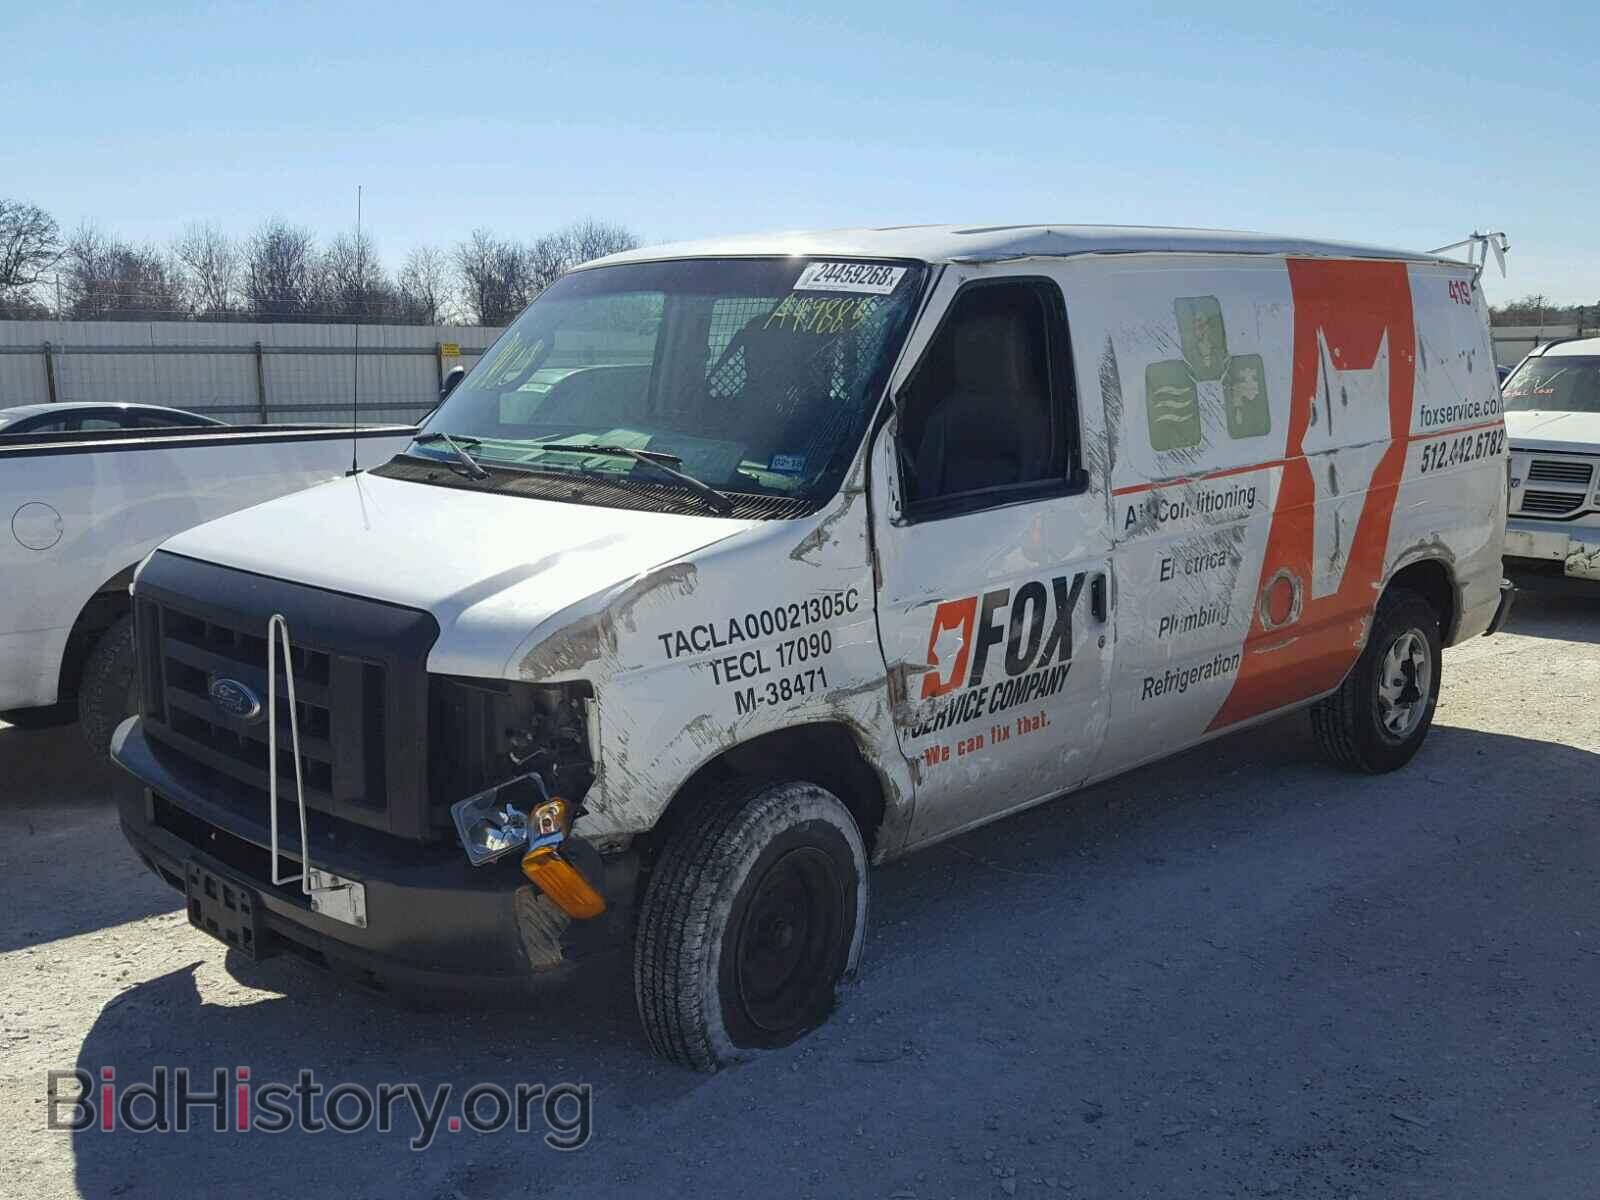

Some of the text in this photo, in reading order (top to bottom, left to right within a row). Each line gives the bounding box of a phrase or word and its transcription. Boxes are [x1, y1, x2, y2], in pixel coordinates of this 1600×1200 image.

[1448, 280, 1471, 306] 419
[1124, 504, 1153, 530] Ai
[1160, 550, 1230, 582] Elctrica
[658, 588, 859, 660] TACLA00021305C
[968, 571, 1088, 688] FOX
[708, 629, 832, 685] TECL 17090
[1142, 653, 1240, 701] Refrigeration
[734, 666, 828, 715] M-38471
[989, 663, 1072, 714] COMPANY
[924, 710, 1051, 767] We can fix that.
